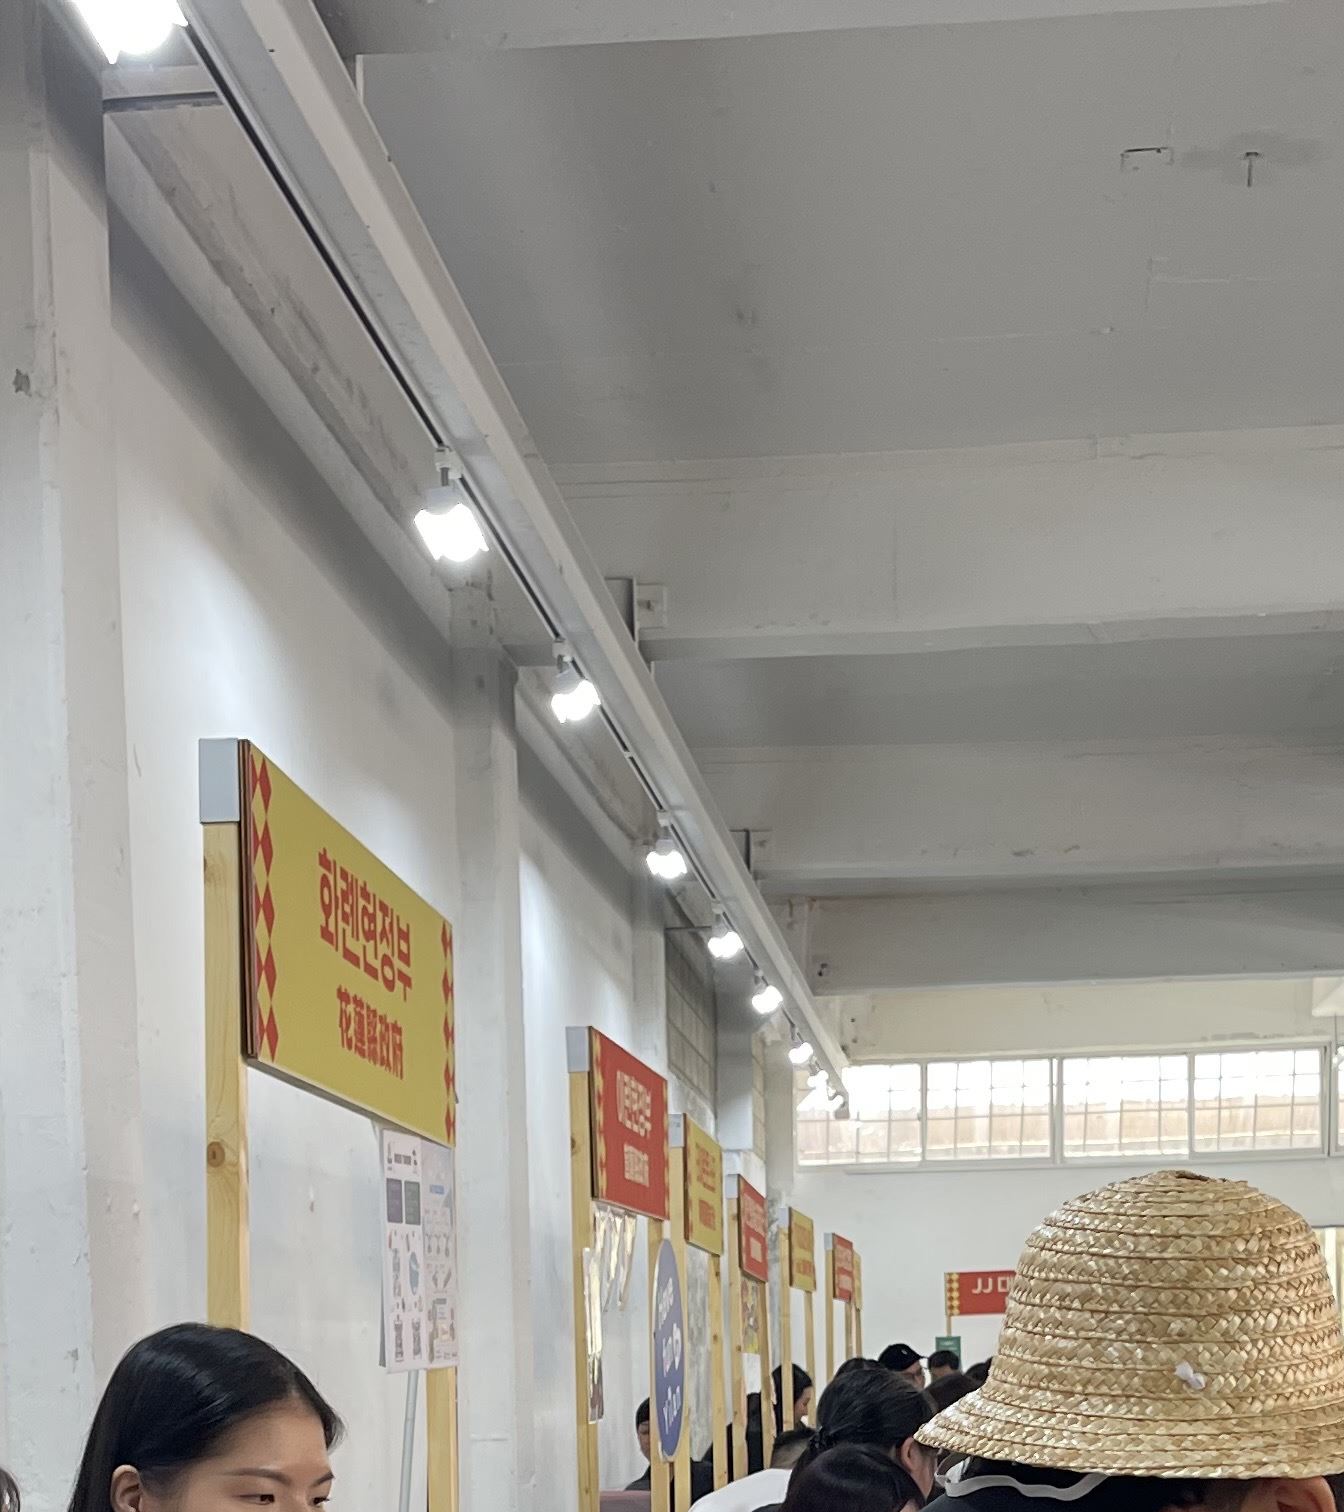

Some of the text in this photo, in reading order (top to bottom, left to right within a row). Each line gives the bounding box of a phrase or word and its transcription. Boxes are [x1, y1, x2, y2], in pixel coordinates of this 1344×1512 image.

[318, 848, 413, 1002] 화롄현정부
[336, 985, 405, 1080] 花蓮縣政府
